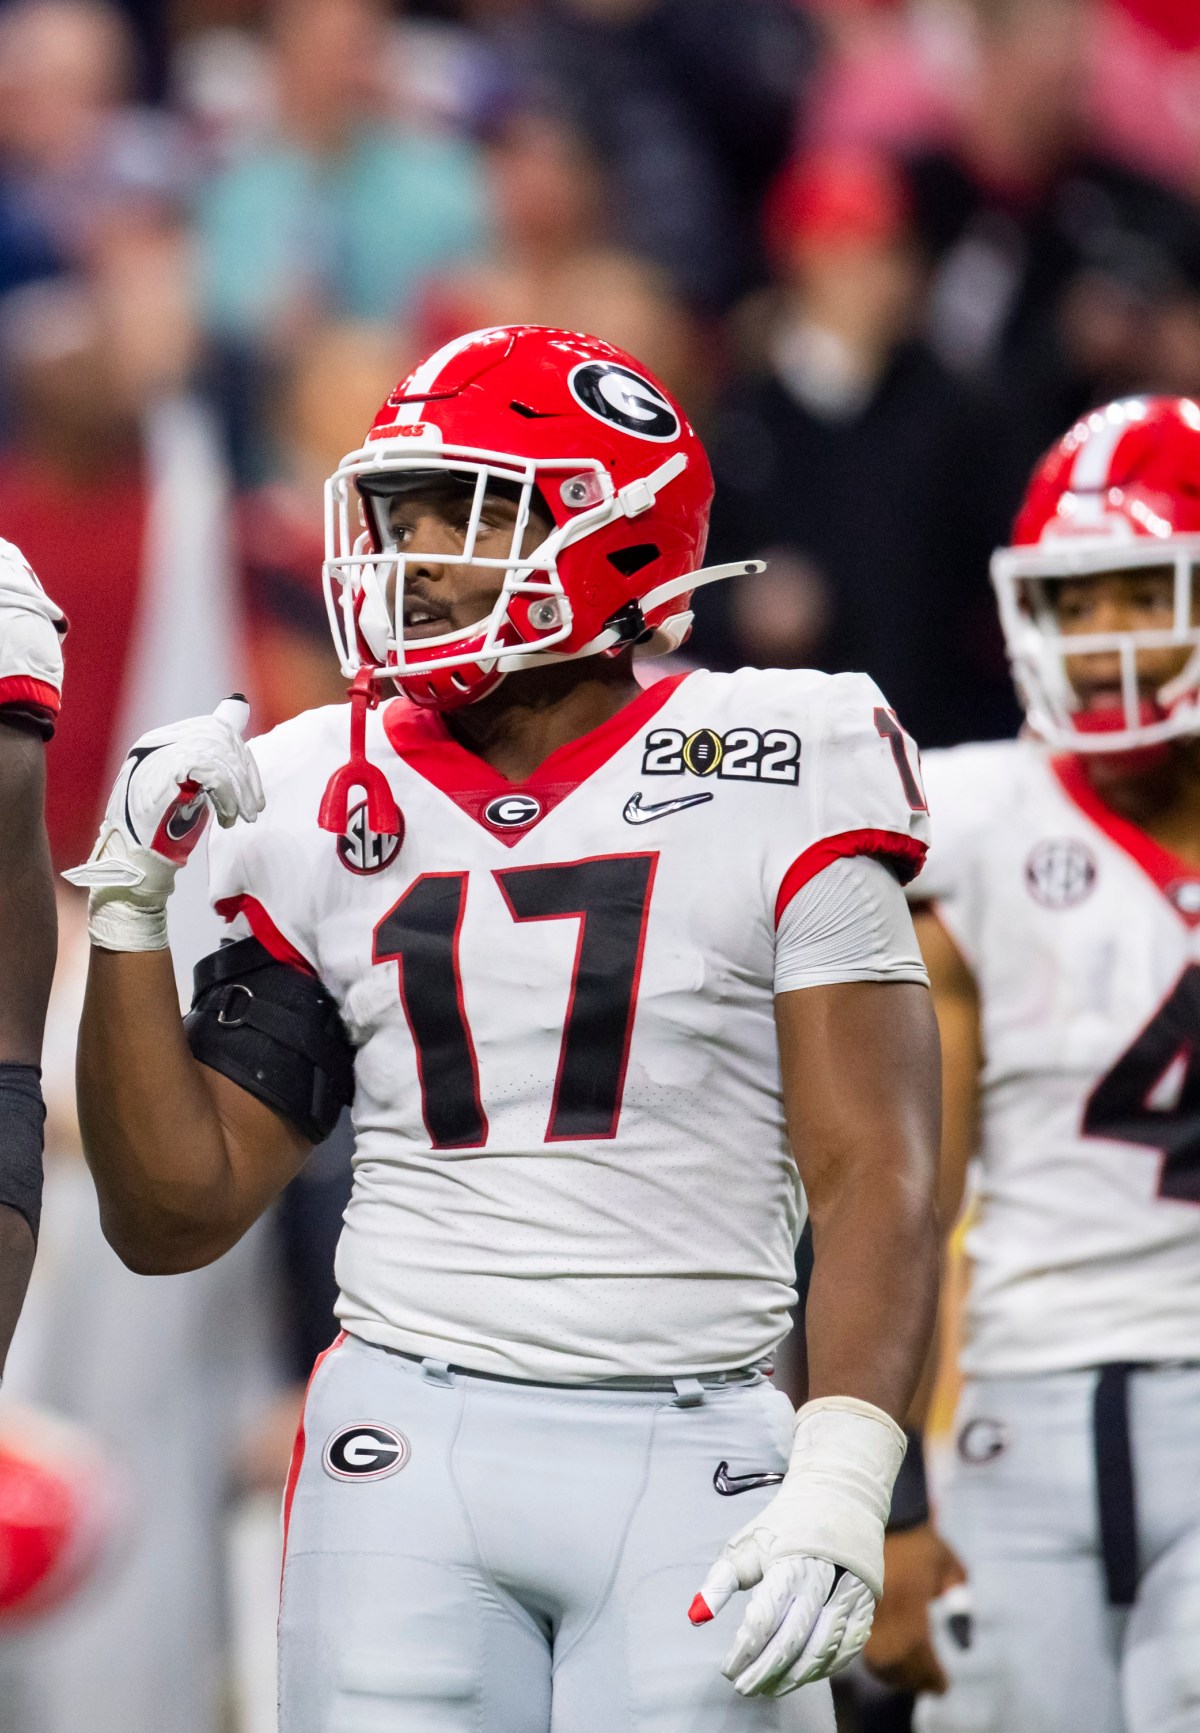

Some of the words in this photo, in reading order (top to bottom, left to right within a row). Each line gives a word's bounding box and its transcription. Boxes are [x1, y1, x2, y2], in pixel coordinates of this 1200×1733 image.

[571, 362, 679, 439] G
[872, 706, 931, 817] 1
[485, 794, 541, 827] G
[371, 850, 661, 1150] 17
[327, 1424, 403, 1477] G
